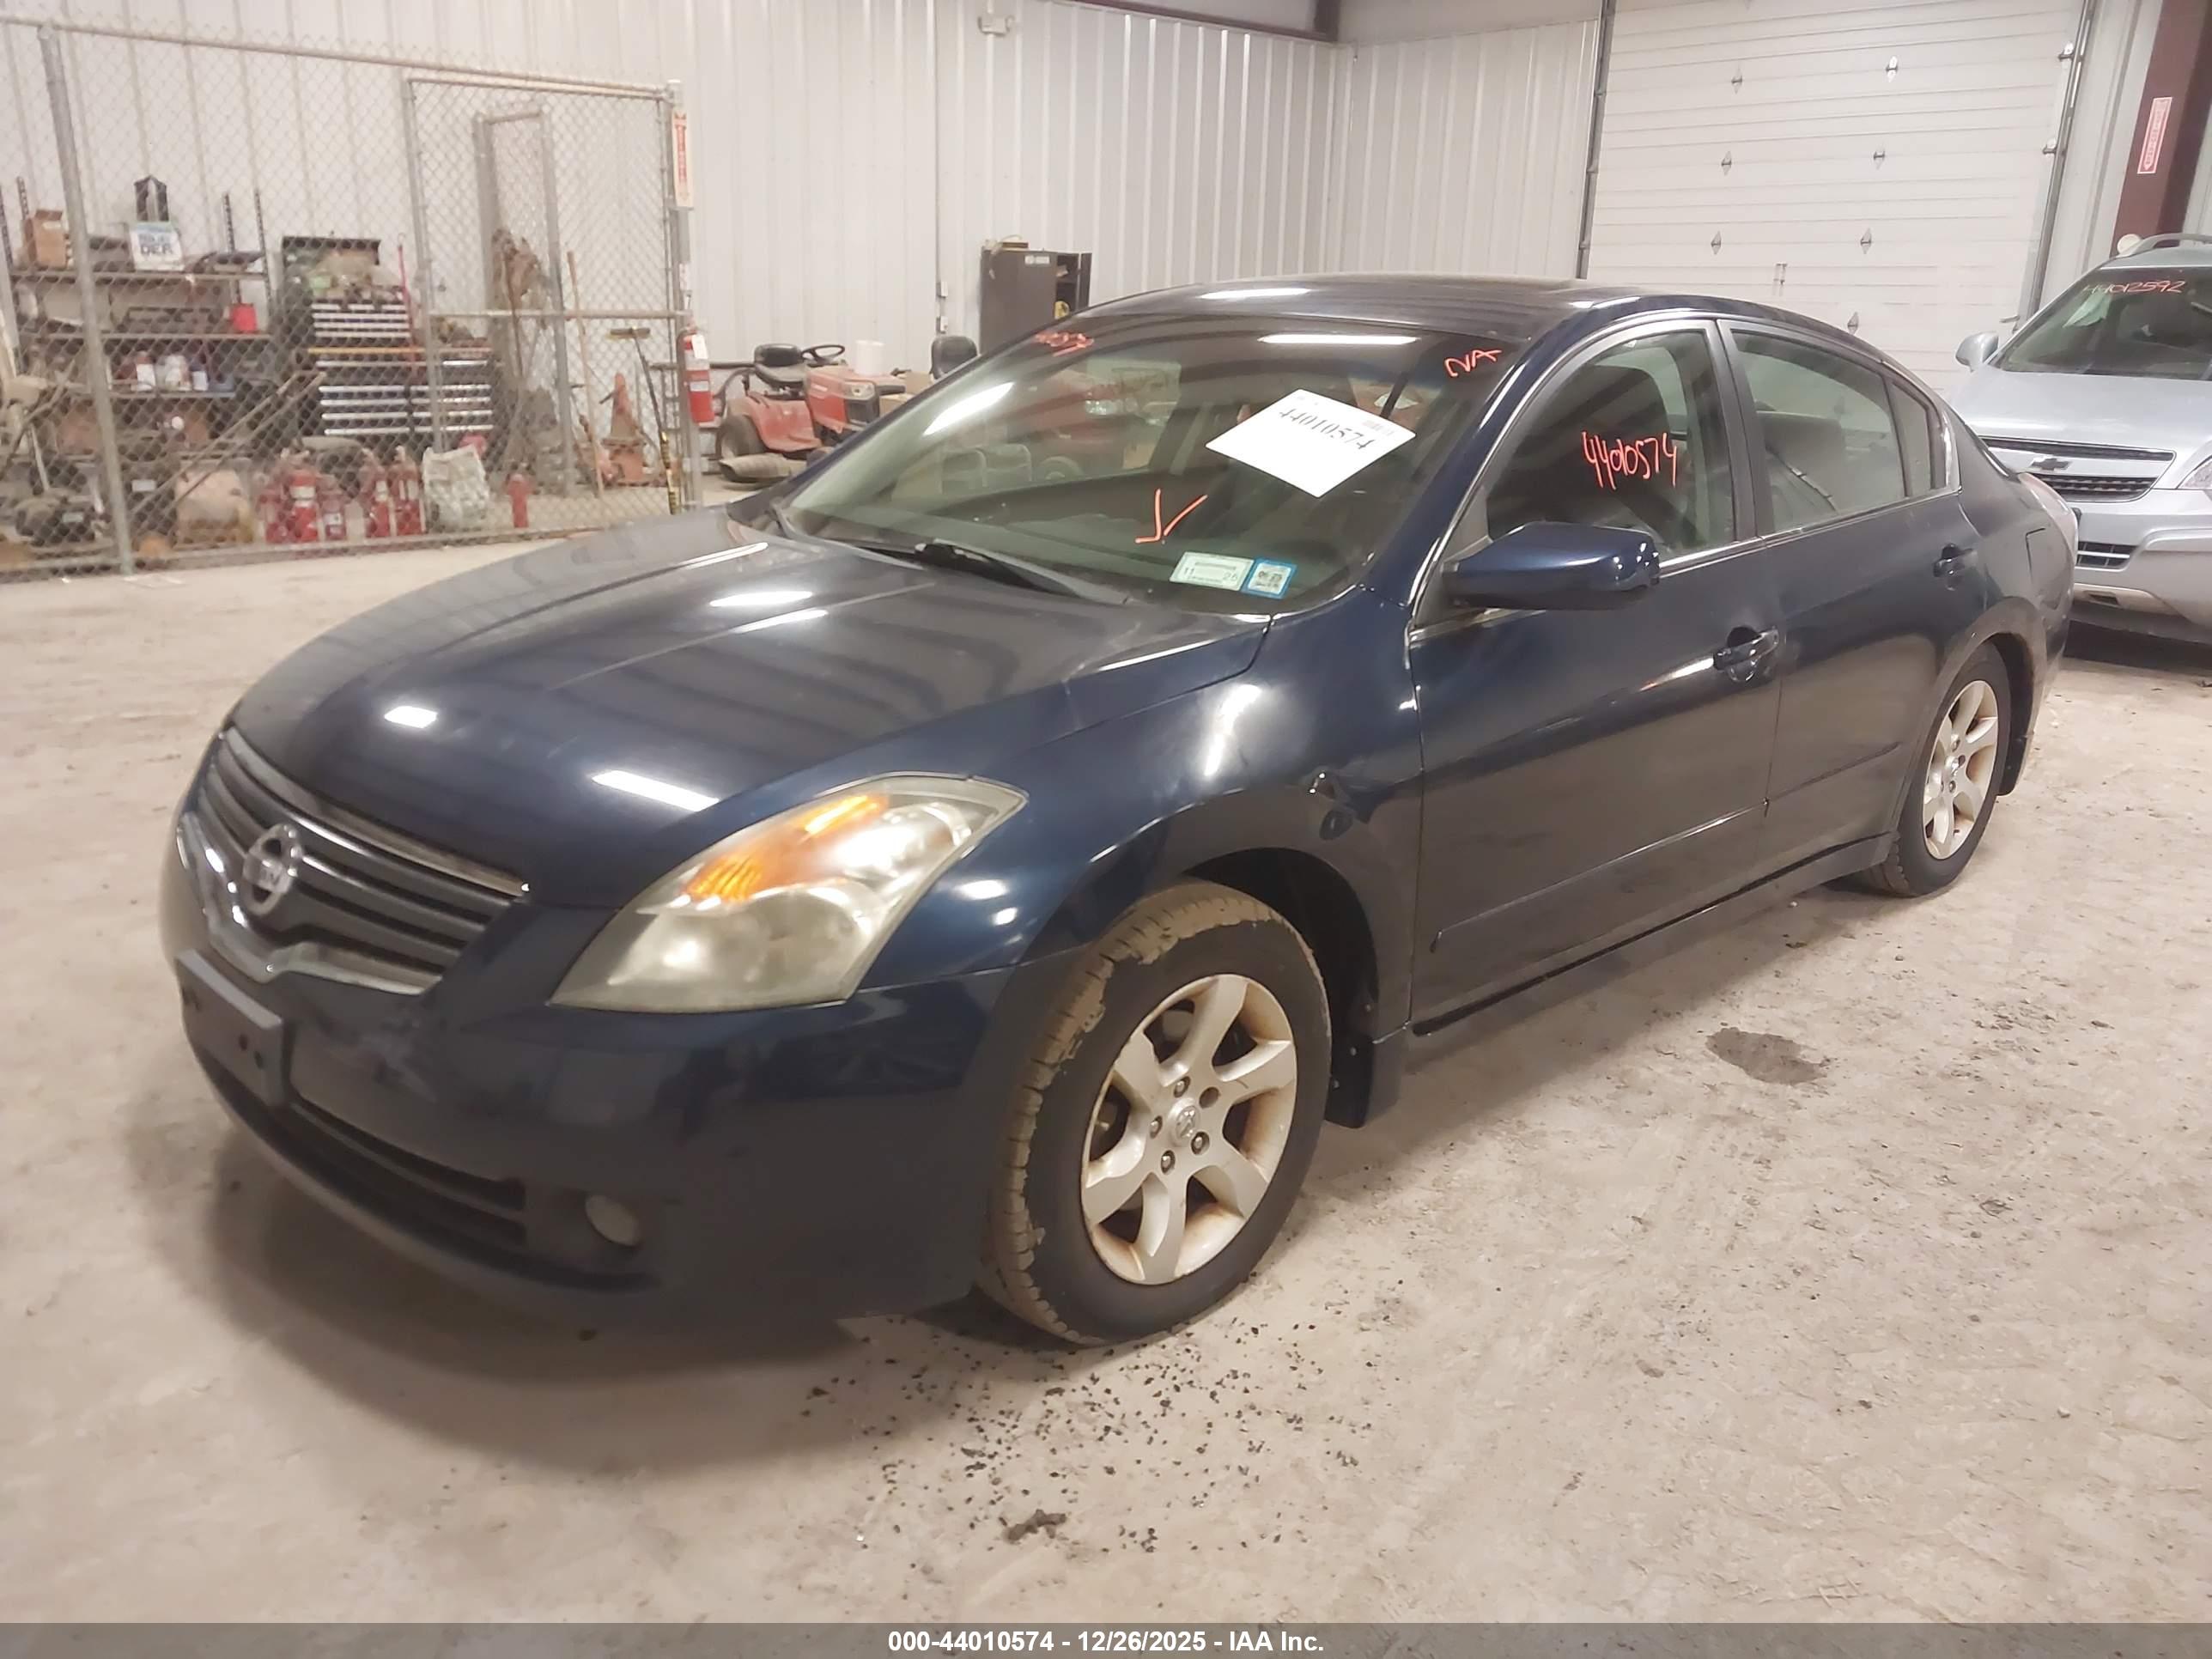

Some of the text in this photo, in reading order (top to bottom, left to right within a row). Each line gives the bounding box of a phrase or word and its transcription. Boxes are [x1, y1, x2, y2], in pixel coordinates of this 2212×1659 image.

[1444, 349, 1503, 377] NA
[1279, 408, 1376, 450] 44010574
[1582, 431, 1677, 490] 44010574
